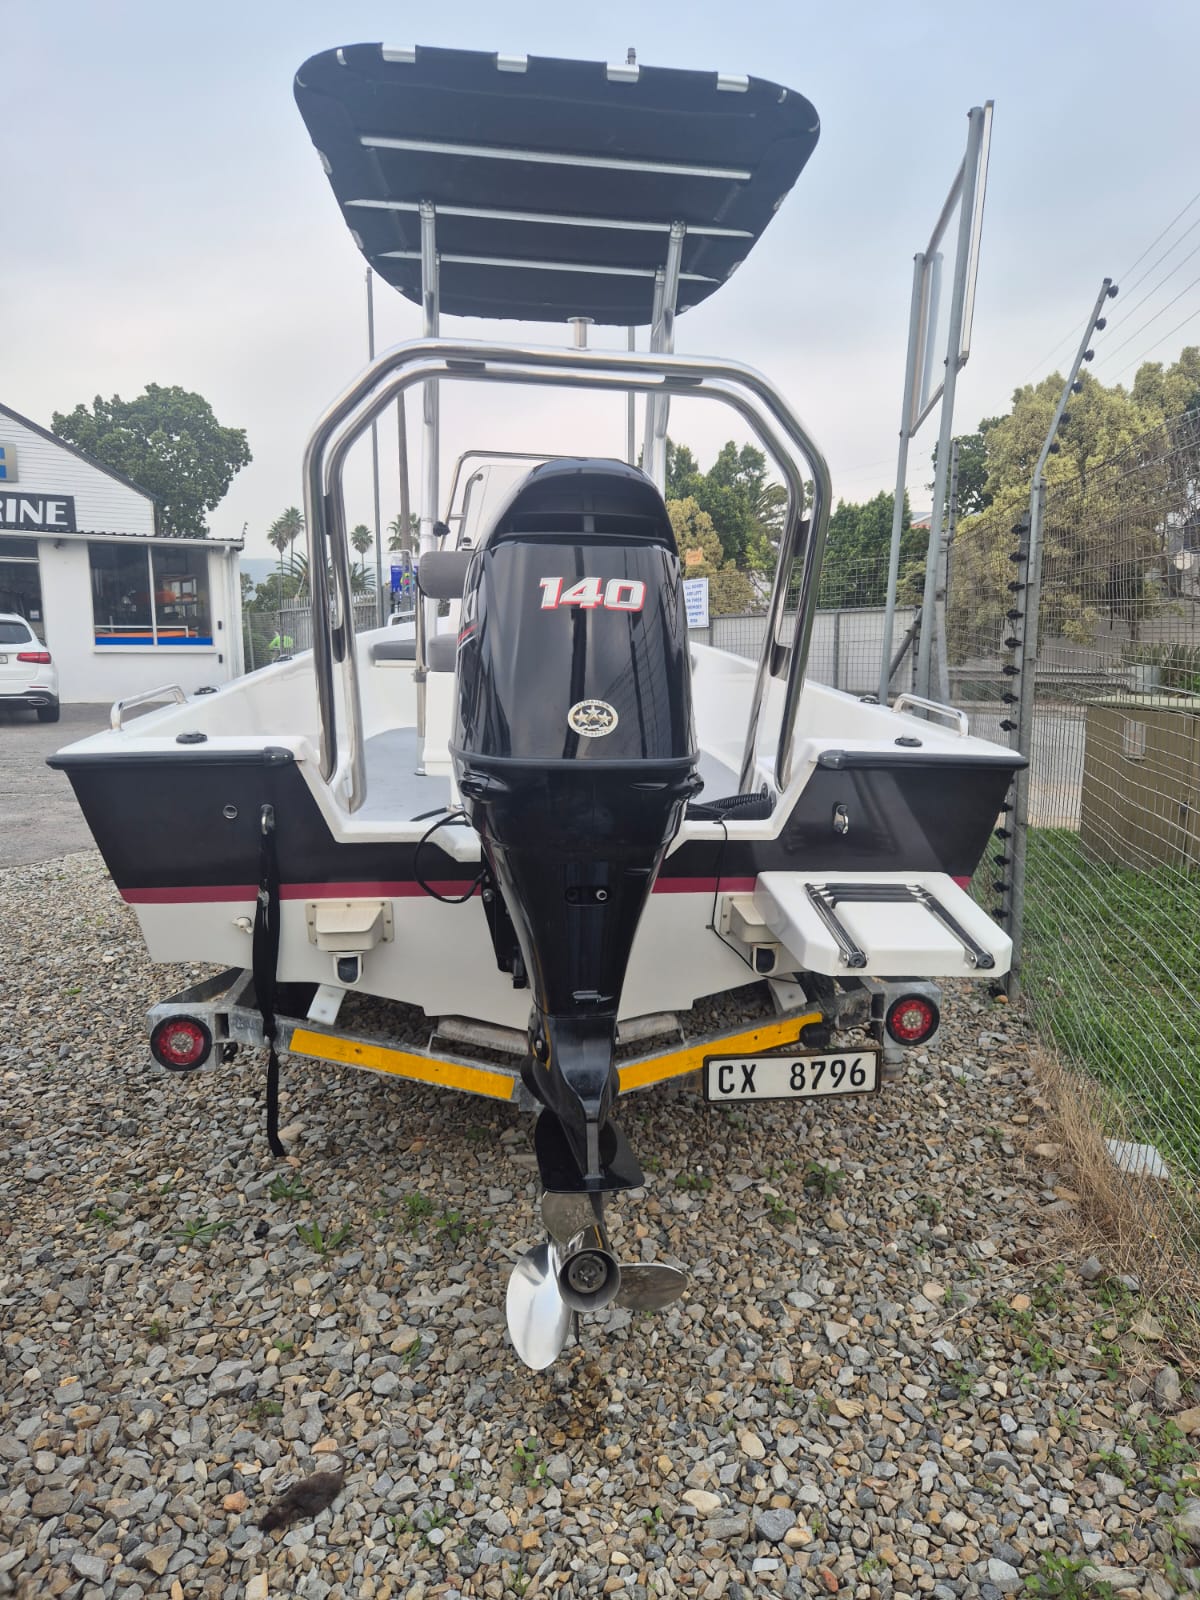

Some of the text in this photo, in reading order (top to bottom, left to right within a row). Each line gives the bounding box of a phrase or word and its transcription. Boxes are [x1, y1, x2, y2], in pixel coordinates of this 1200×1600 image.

[0, 498, 68, 525] INE
[539, 577, 646, 611] 140
[718, 1058, 866, 1094] CX 8796
